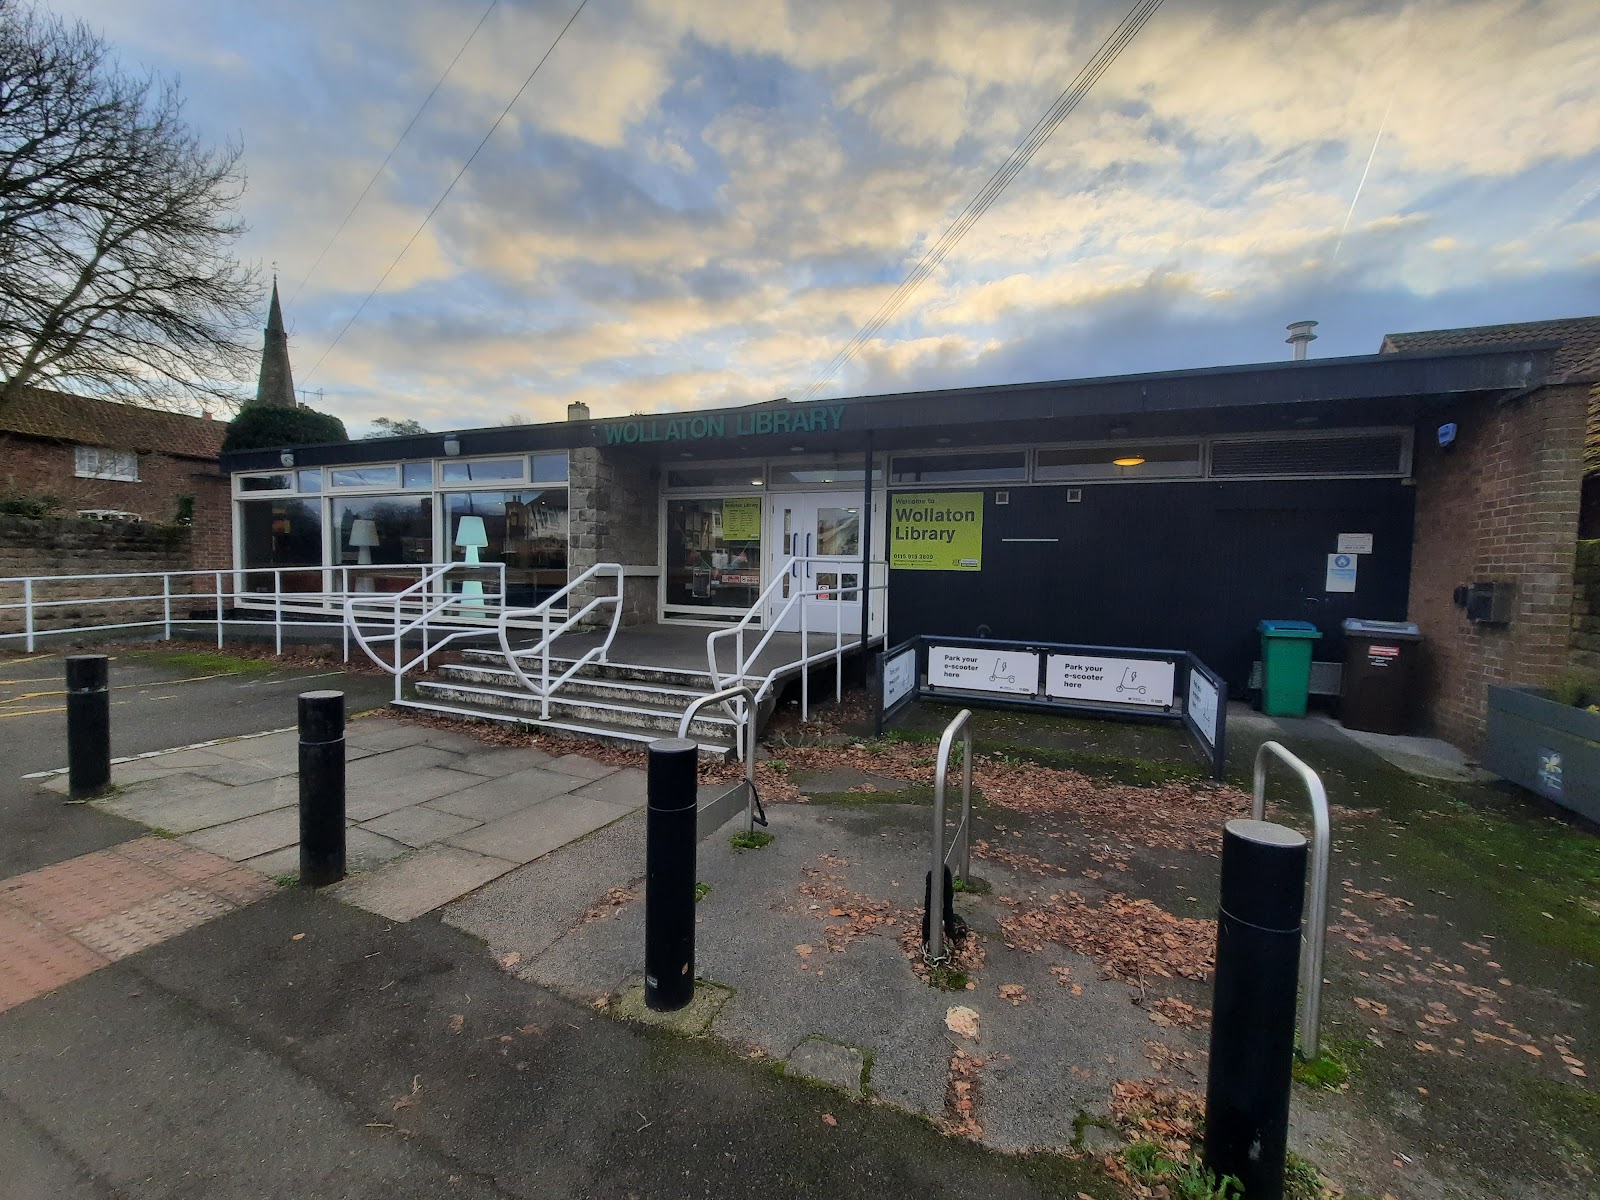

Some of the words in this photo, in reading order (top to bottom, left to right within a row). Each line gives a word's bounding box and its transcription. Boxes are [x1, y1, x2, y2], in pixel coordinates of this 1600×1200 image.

[604, 415, 725, 445] WOLLATON
[736, 405, 846, 435] LIBRARY
[895, 508, 975, 522] Wollaton
[895, 526, 956, 543] Library
[944, 654, 960, 662] Park
[944, 663, 979, 671] e-scooter
[1065, 663, 1082, 672] Park
[1064, 673, 1104, 681] e-scooter
[1064, 681, 1082, 689] here
